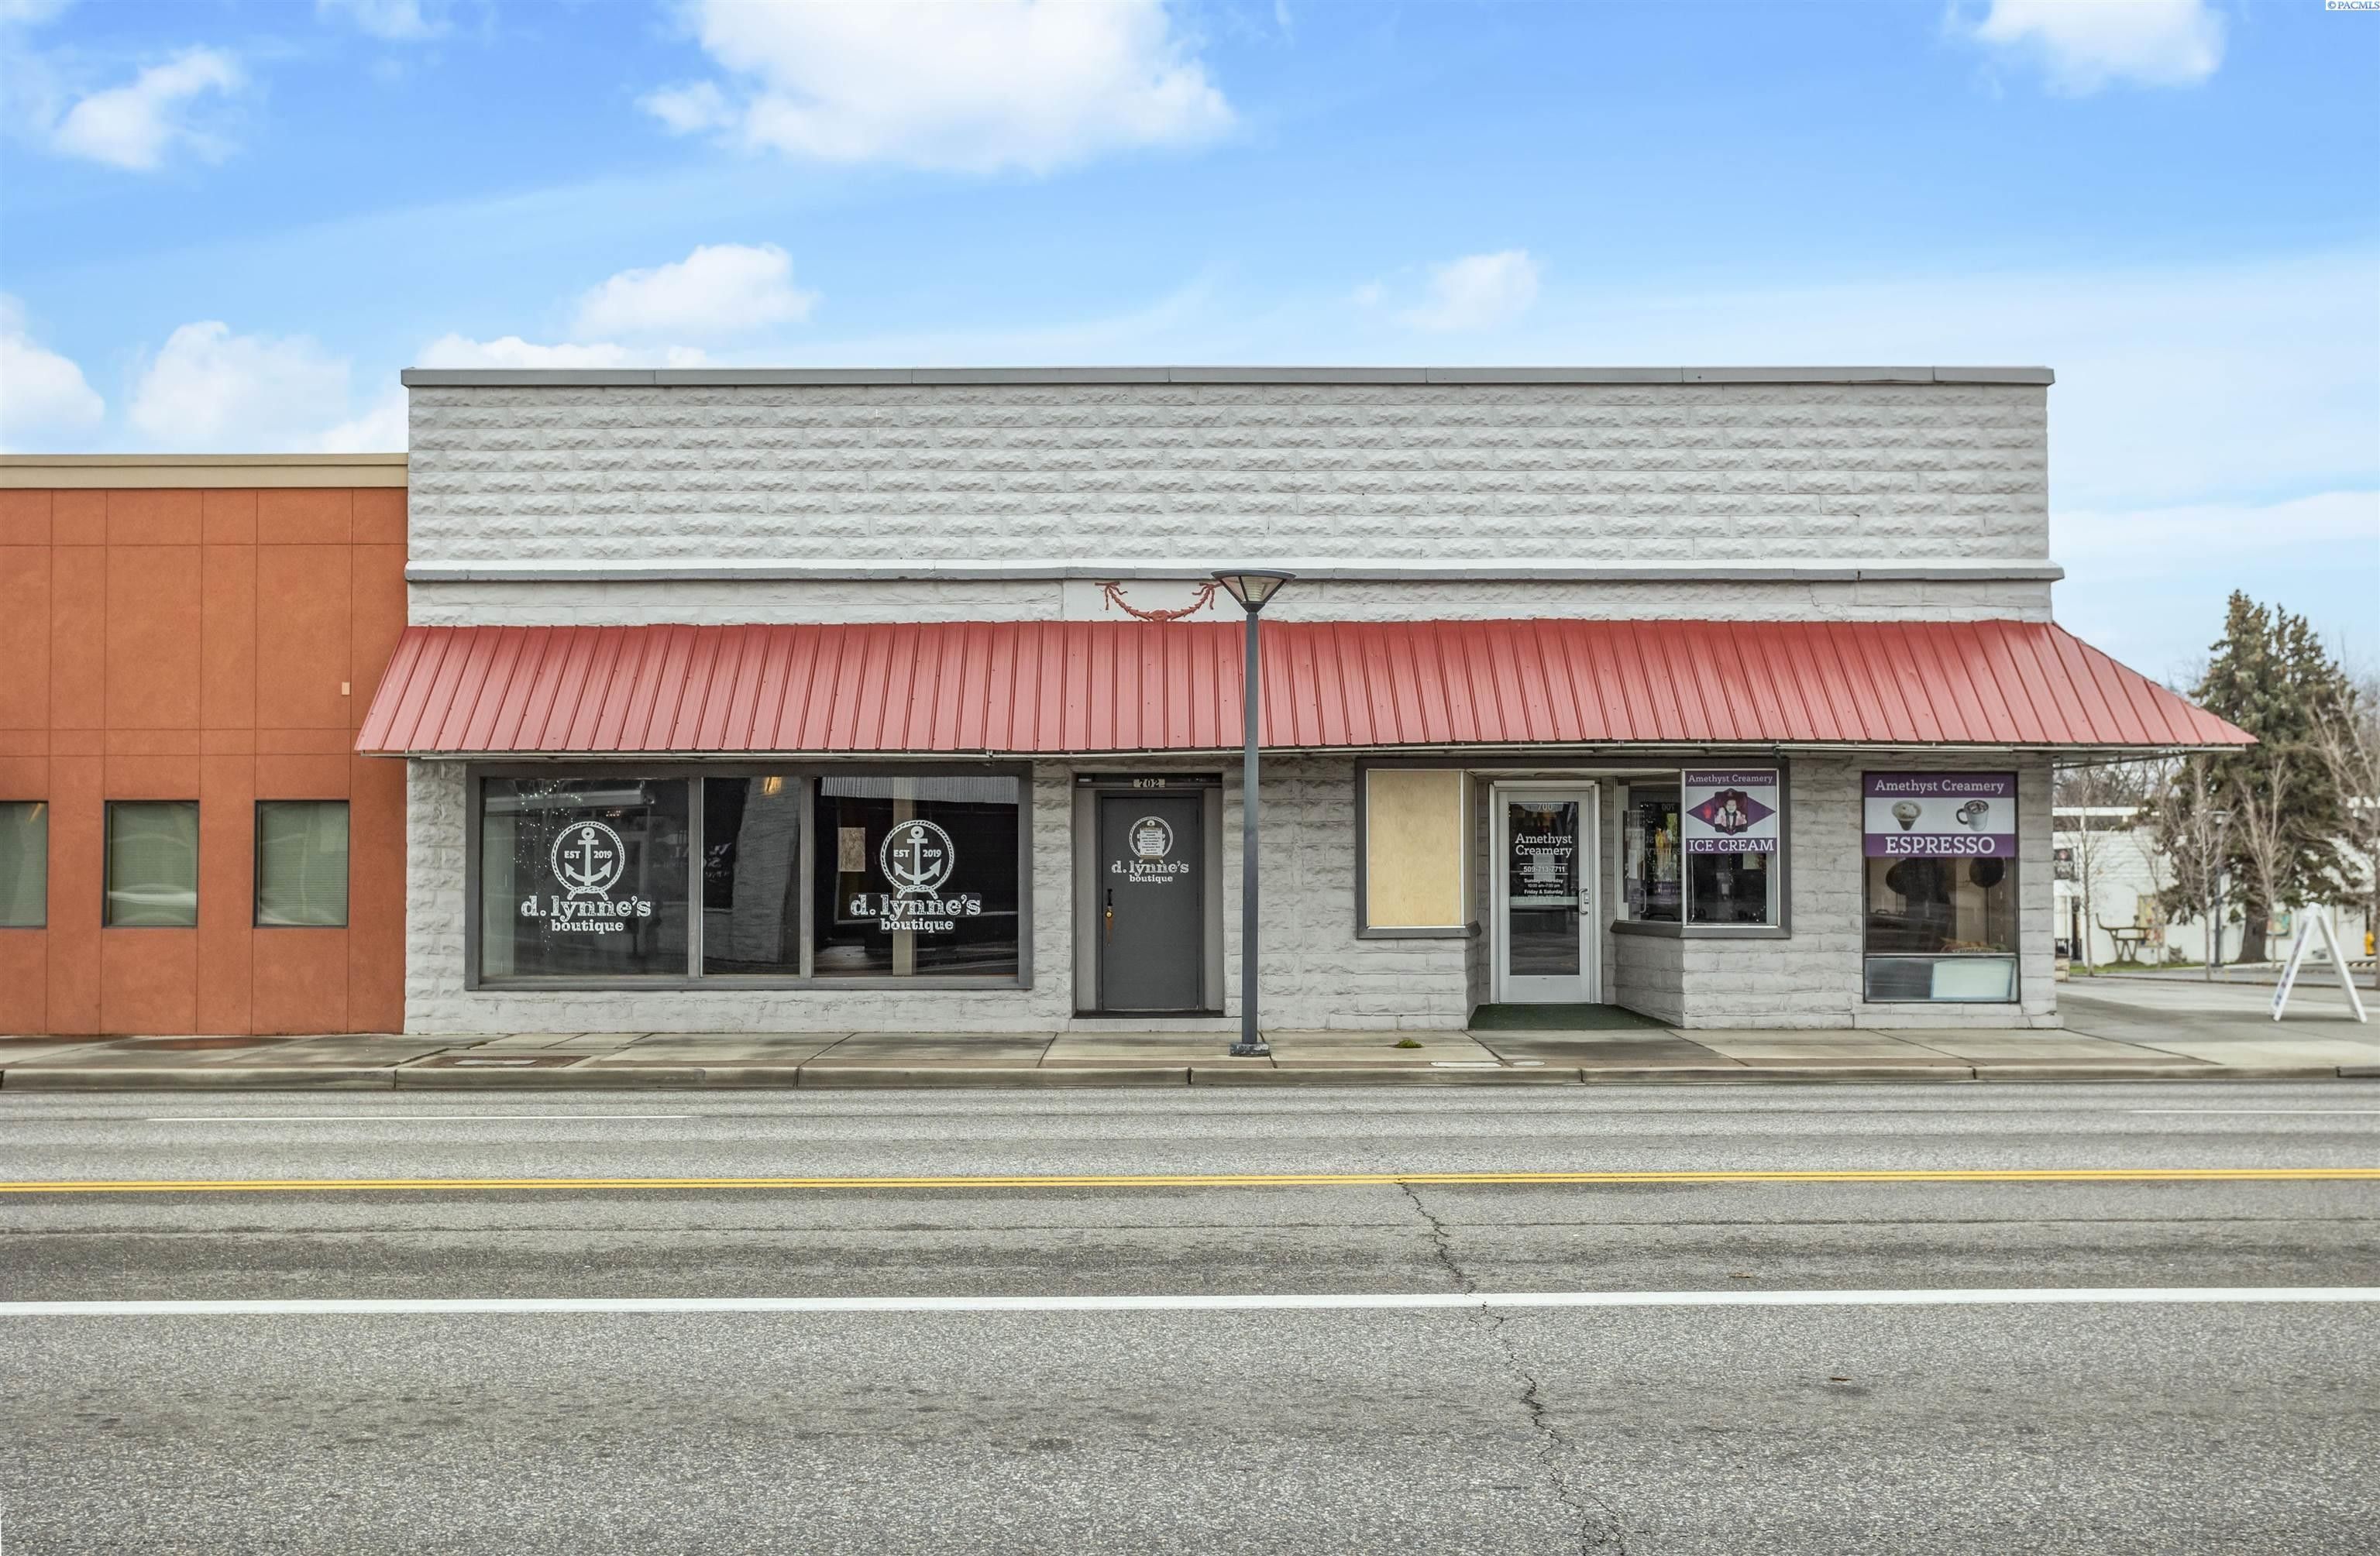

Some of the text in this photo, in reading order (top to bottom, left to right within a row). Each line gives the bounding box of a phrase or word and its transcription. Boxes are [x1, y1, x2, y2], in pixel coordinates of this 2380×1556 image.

[1139, 779, 1160, 788] 702
[1688, 774, 1773, 784] Amethyst Creamery
[1875, 779, 2005, 795] Amethyst Creamery
[1536, 803, 1553, 812] 700
[1515, 833, 1573, 847] Amethyst
[1689, 840, 1714, 852] ICE
[1718, 839, 1774, 851] CREAM
[1885, 836, 1996, 854] ESPRESSO
[564, 850, 613, 860] EST 2019
[893, 849, 942, 858] EST 2019
[1515, 845, 1573, 859] Creamery
[1130, 874, 1173, 884] boutique
[551, 919, 624, 934] boutique
[880, 918, 954, 933] boutique
